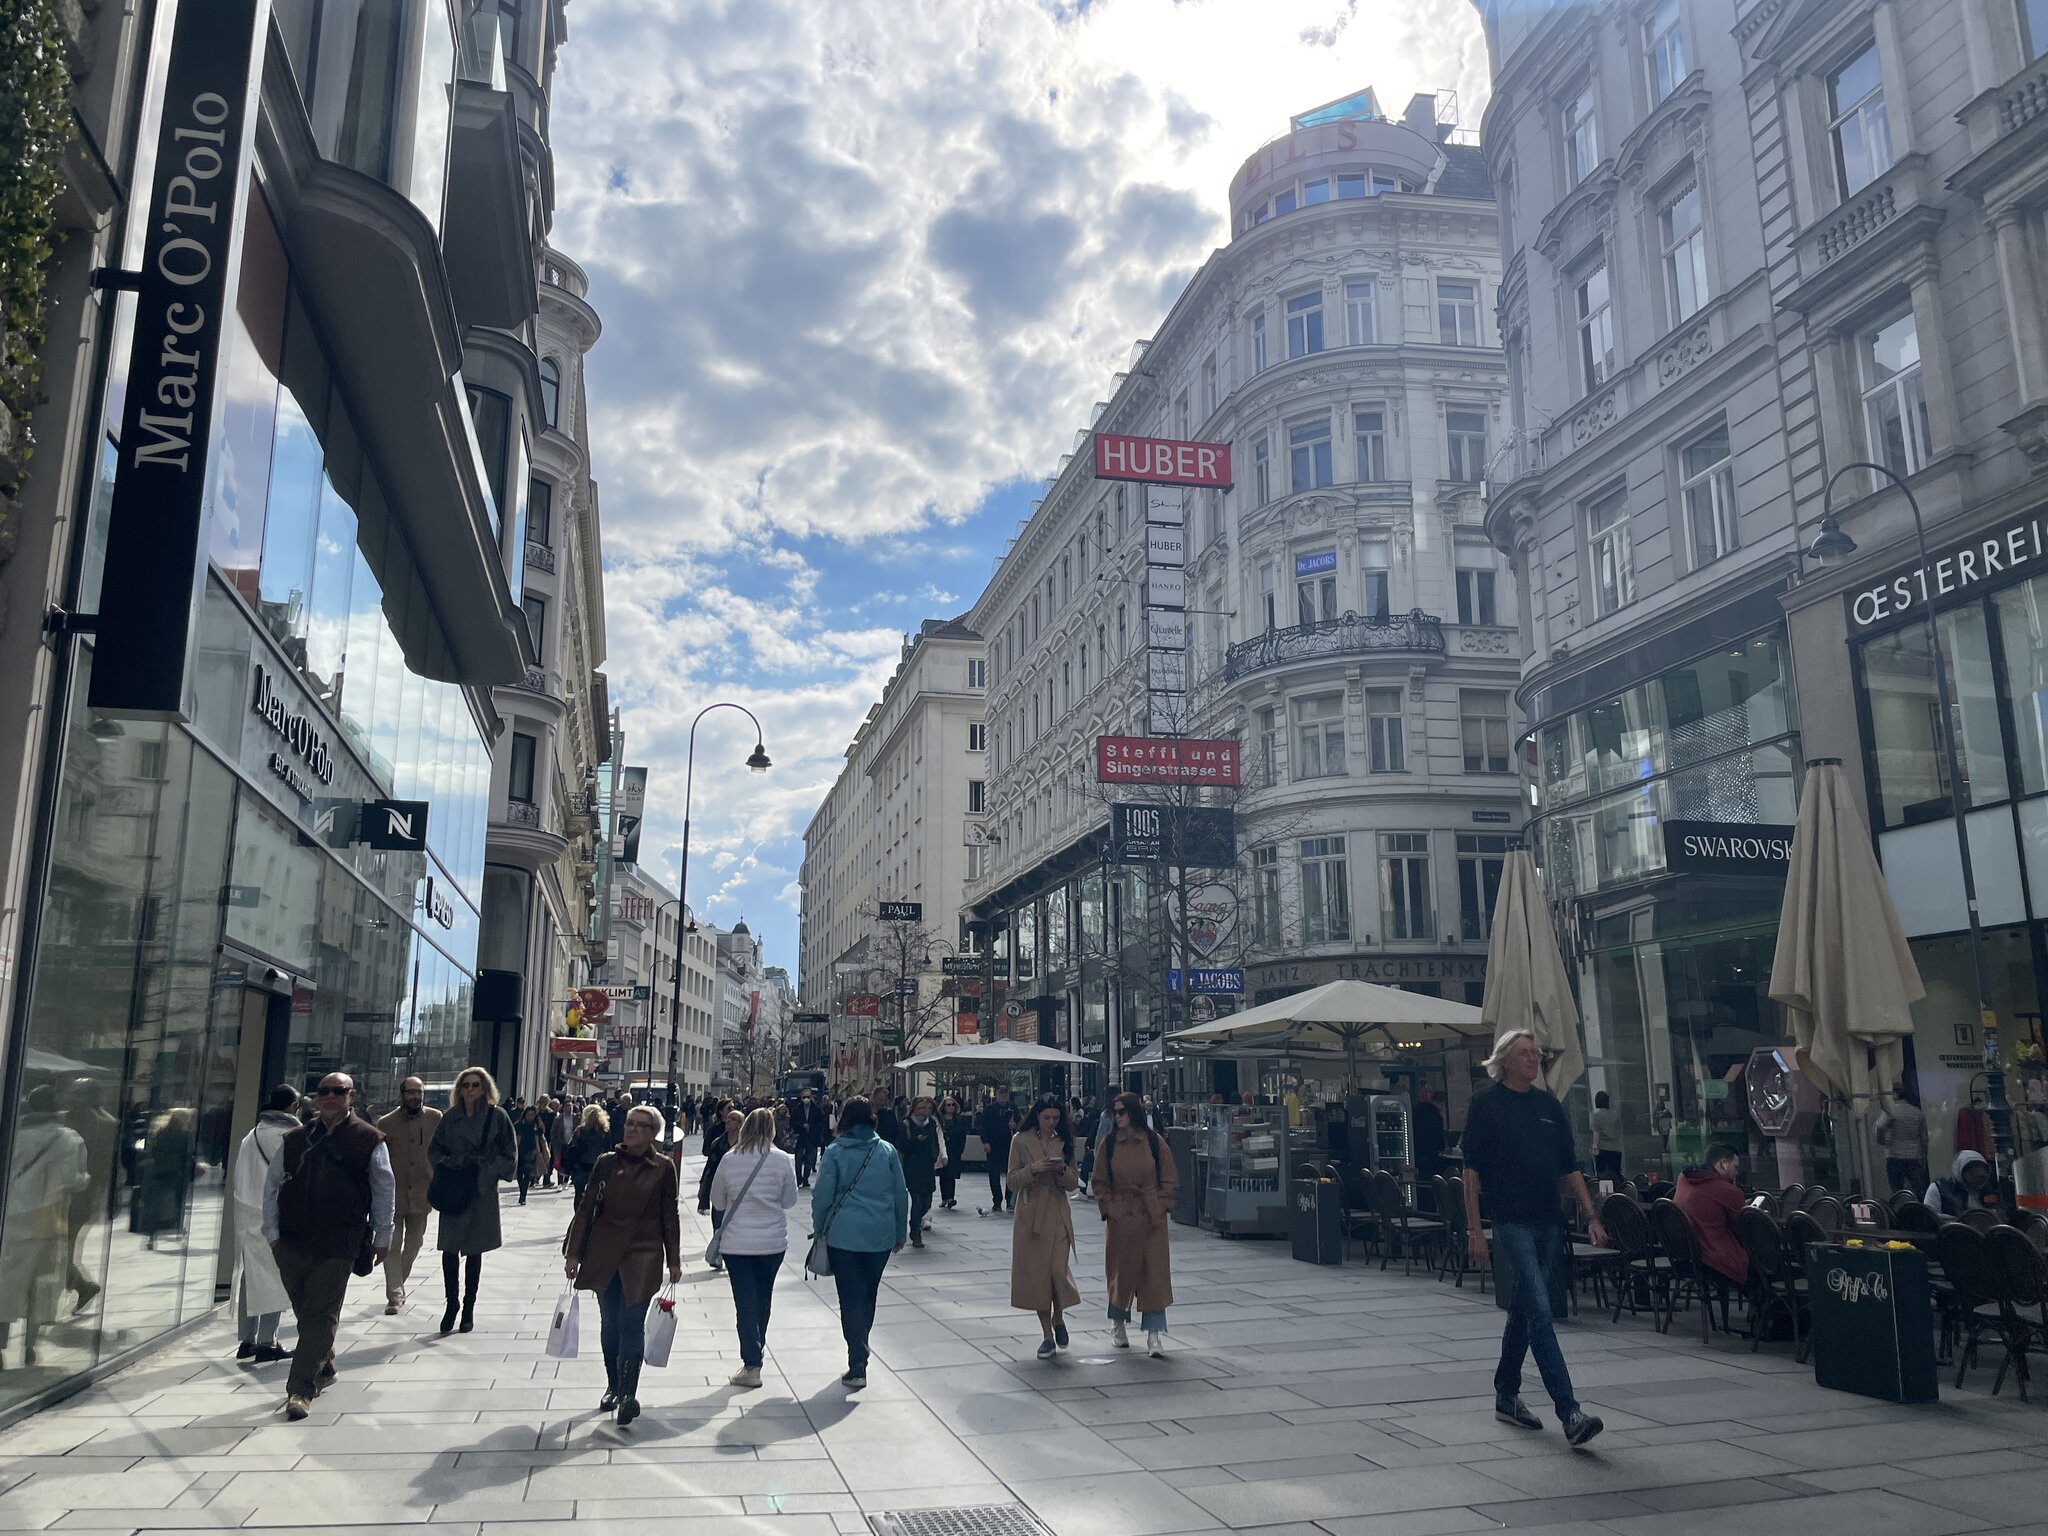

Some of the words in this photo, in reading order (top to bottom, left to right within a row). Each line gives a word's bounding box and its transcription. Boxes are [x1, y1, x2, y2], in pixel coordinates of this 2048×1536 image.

[158, 92, 229, 286] O'Polo
[134, 302, 206, 472] Marc
[1104, 439, 1218, 479] HUBER
[1150, 540, 1183, 552] HUBER
[1308, 553, 1335, 570] JACOBS
[1853, 520, 2048, 626] ŒSTERREI
[1151, 582, 1182, 591] HANRO
[254, 664, 299, 745] Marc
[298, 714, 336, 788] O'Polo
[1106, 744, 1176, 761] Steffl
[1190, 749, 1232, 761] und
[1106, 761, 1218, 777] Singerstrasse
[1221, 764, 1233, 777] 5
[1126, 808, 1160, 838] LOOS
[1683, 835, 1794, 861] SWAROVSK
[888, 905, 916, 915] PAUL
[1197, 972, 1241, 990] JACOBS
[1261, 966, 1301, 985] LANZ
